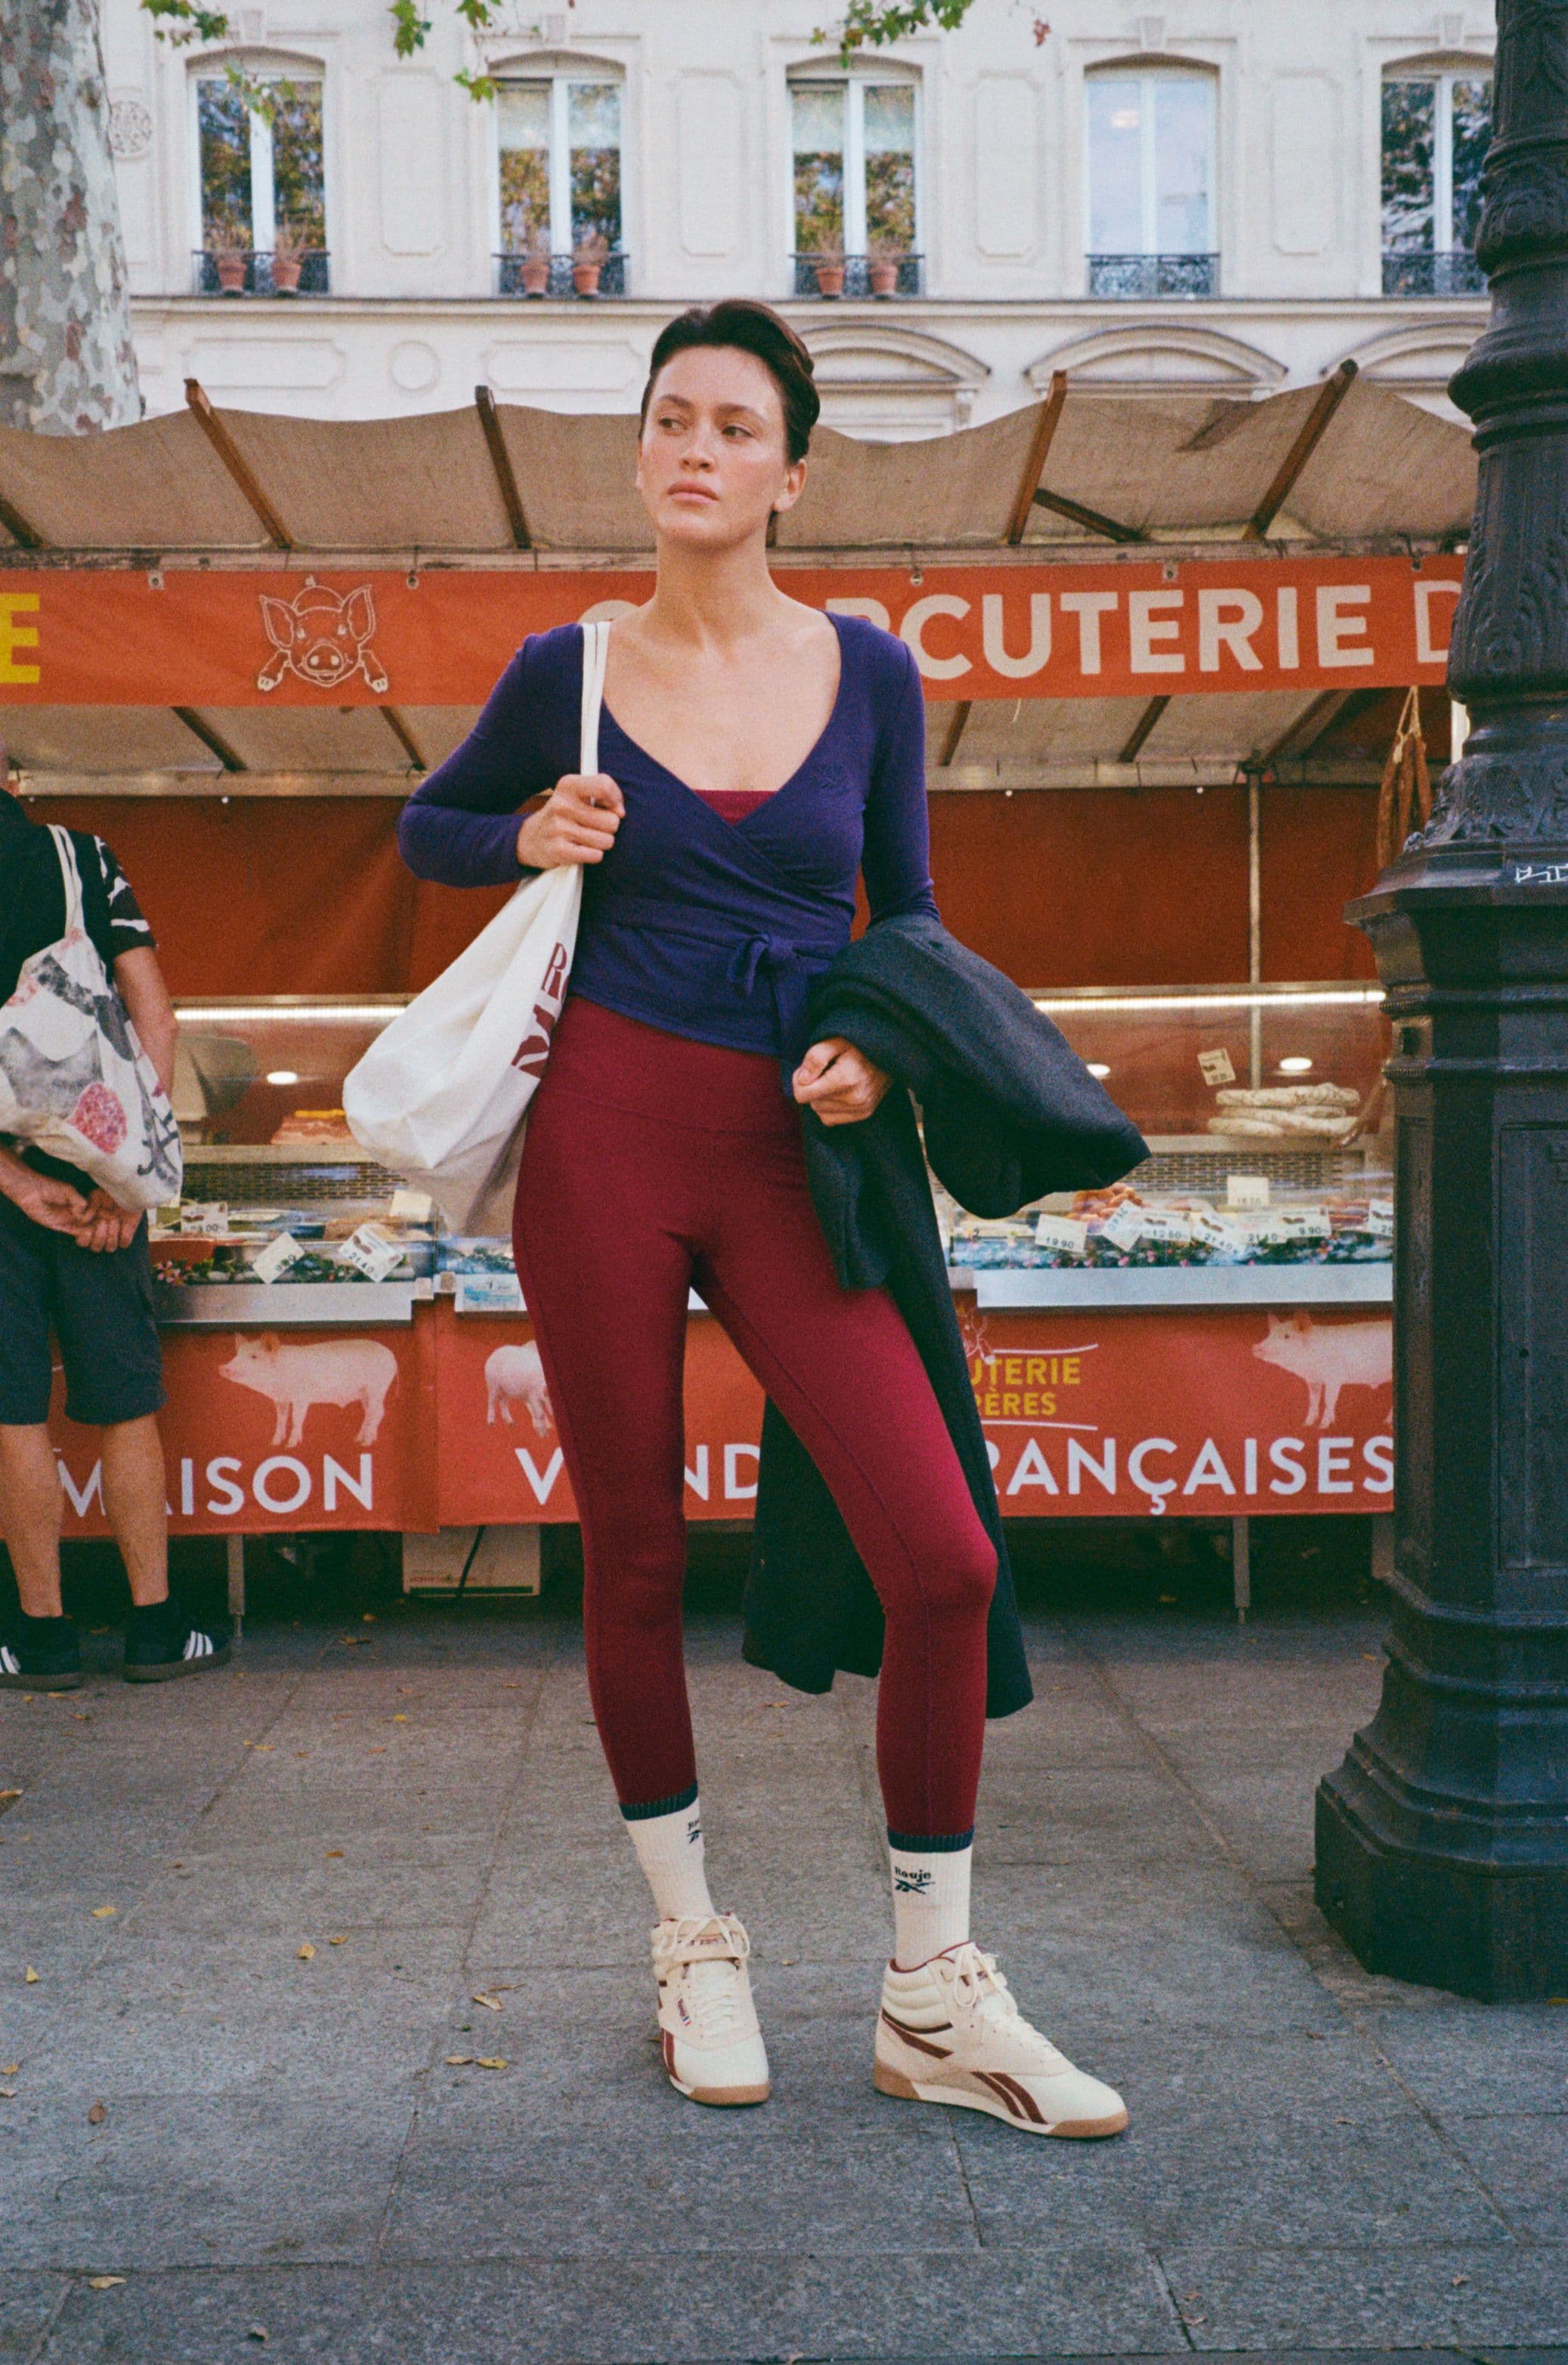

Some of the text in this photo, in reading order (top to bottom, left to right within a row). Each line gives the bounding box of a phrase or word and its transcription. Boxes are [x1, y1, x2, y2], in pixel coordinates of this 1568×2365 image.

[825, 585, 1375, 680] CUTERIE
[971, 1357, 1081, 1386] UTERIE
[975, 1387, 1057, 1416] ÈRES
[57, 1452, 373, 1517] MISON
[985, 1436, 1393, 1514] ANÇAISES
